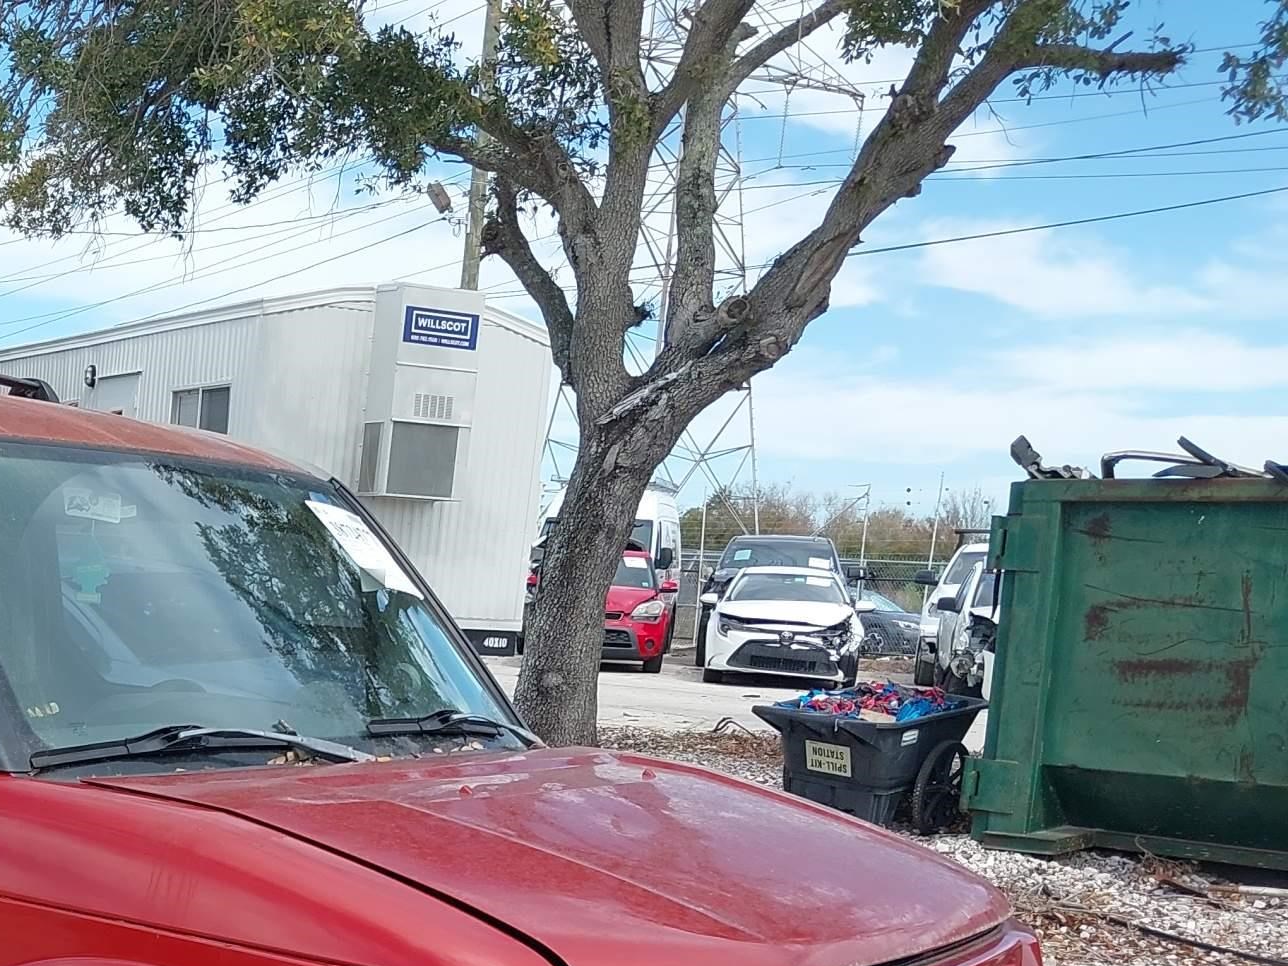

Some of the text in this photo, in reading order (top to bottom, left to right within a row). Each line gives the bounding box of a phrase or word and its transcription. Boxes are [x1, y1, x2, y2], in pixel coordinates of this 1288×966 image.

[417, 316, 467, 333] WILLSCOT
[812, 746, 845, 761] STATION
[810, 757, 848, 774] SPILL-KIT
